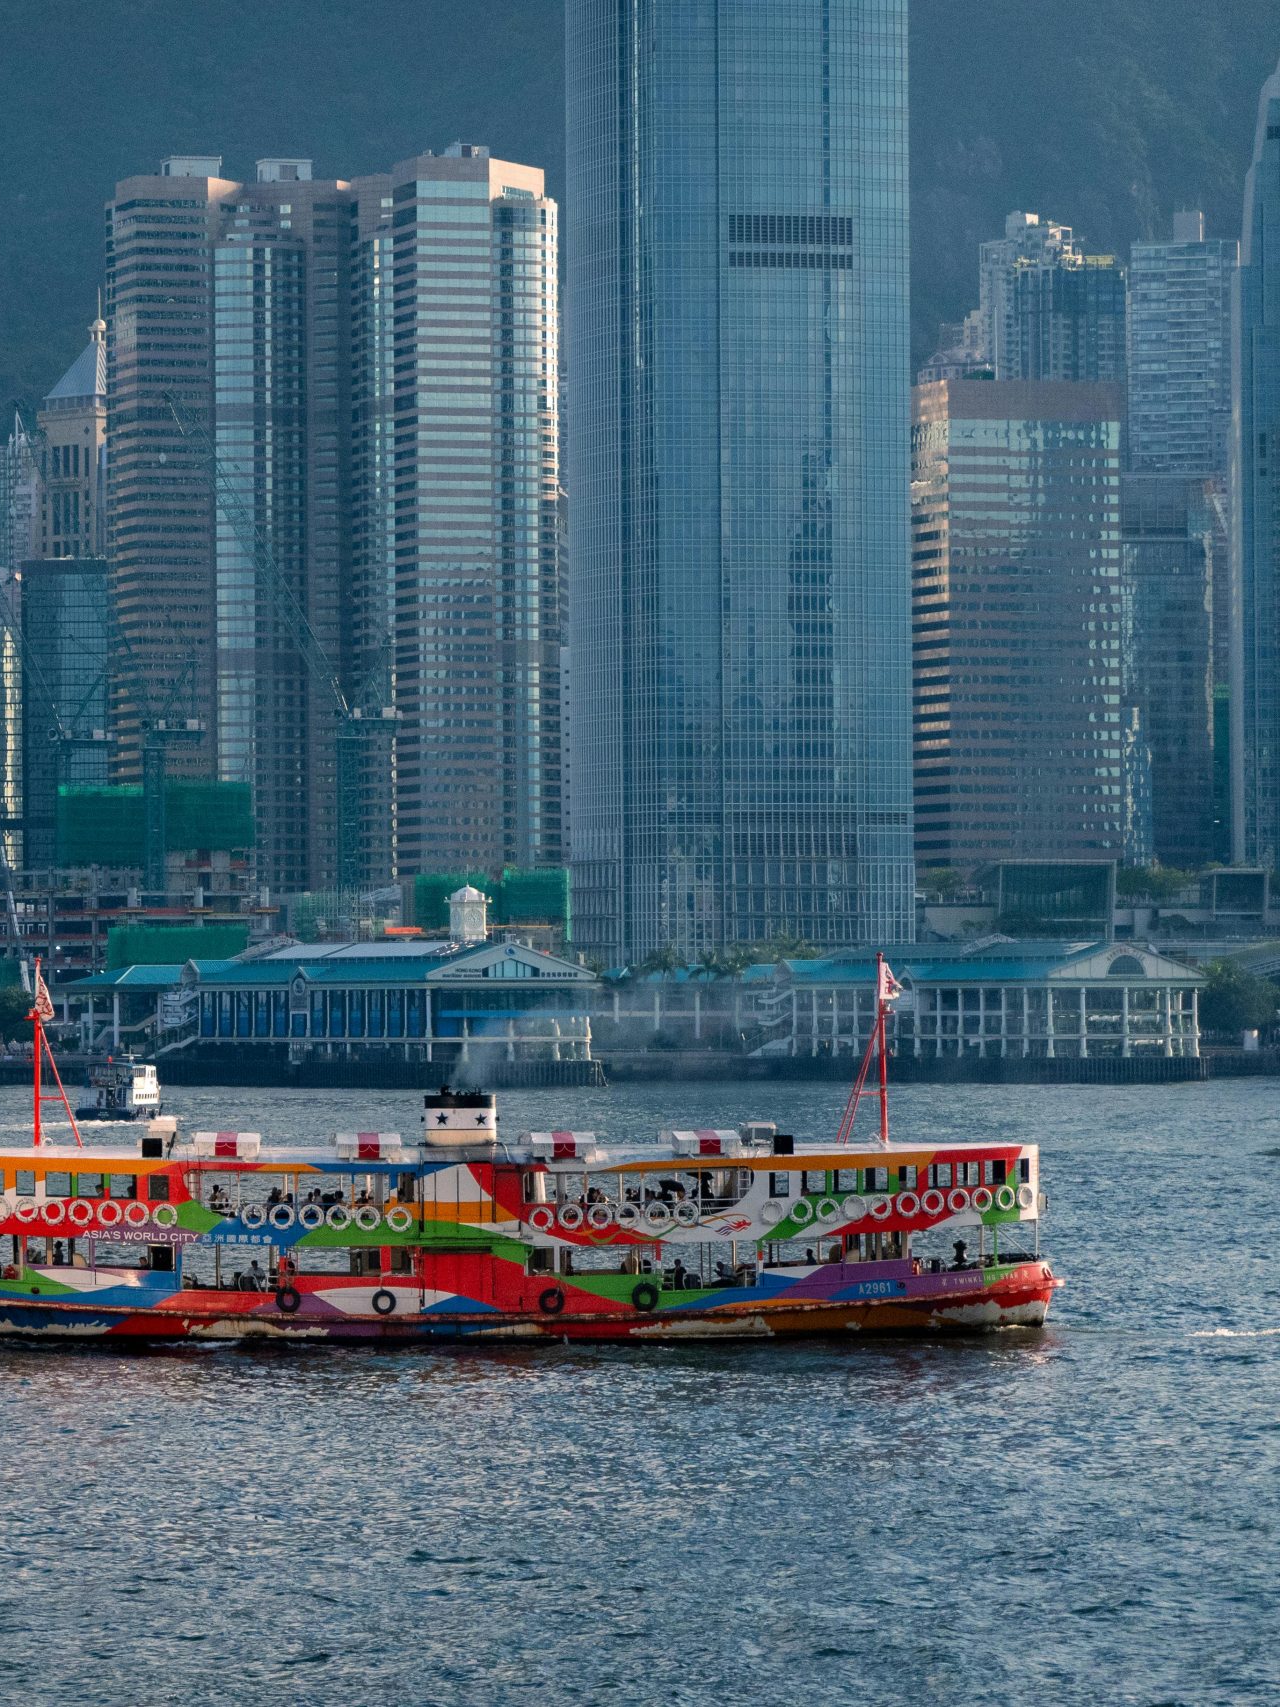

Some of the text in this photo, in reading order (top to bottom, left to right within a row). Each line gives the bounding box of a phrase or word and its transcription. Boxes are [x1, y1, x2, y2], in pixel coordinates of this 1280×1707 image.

[82, 1230, 199, 1242] ASIA'S WORLD CITY
[858, 1282, 892, 1295] A2961
